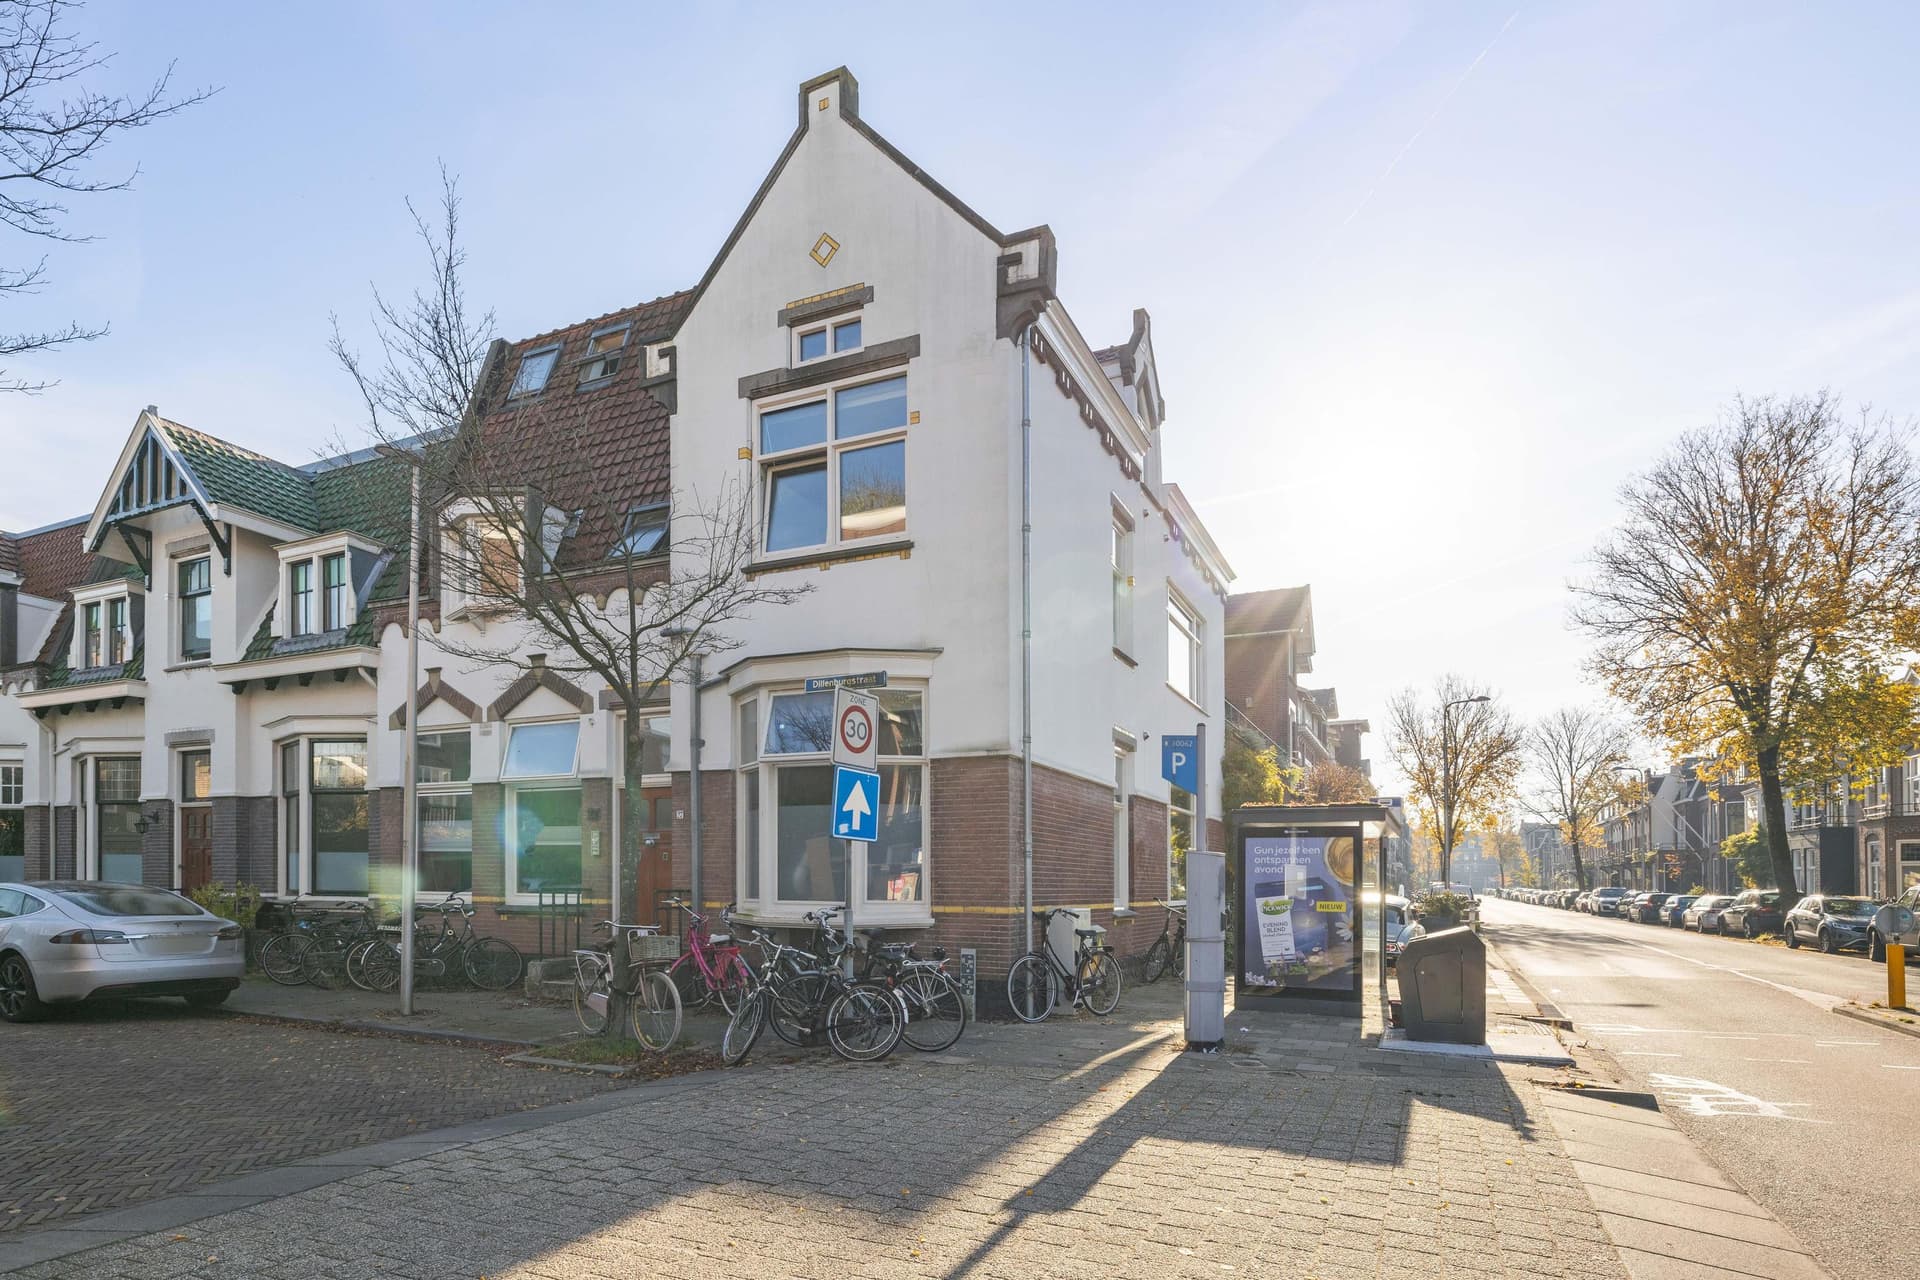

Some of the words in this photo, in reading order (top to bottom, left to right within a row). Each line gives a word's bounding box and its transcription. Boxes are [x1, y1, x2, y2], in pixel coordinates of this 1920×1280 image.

[849, 695, 867, 706] ZONE
[846, 718, 868, 741] 30
[1172, 752, 1186, 774] P
[1254, 846, 1274, 855] Gun
[1274, 845, 1301, 856] jezelf
[1254, 856, 1311, 865] ontspannen
[1254, 866, 1284, 874] avond
[1319, 903, 1344, 911] NIEUW
